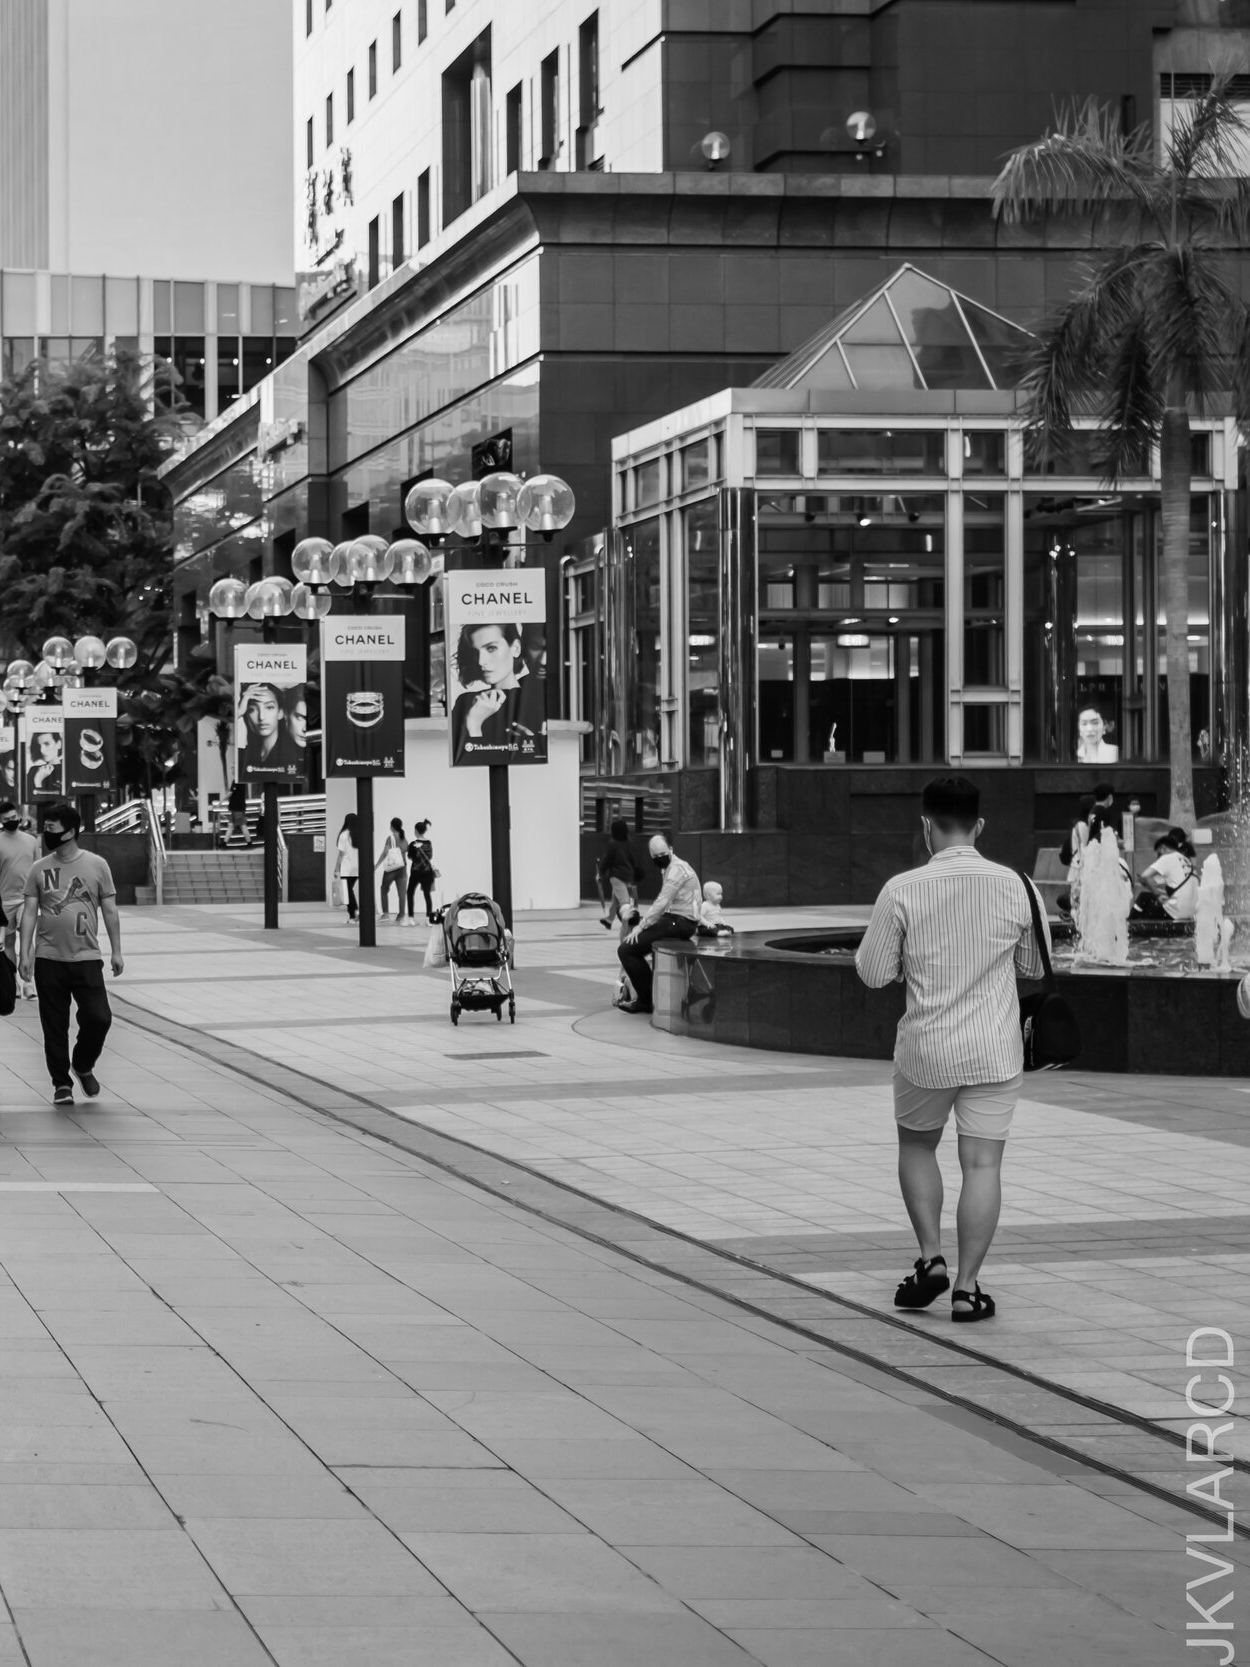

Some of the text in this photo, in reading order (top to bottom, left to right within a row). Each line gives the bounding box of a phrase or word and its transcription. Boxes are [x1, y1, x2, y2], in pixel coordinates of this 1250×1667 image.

[461, 592, 533, 605] CHANEL
[335, 635, 395, 645] CHANEL
[246, 660, 298, 670] CHANEL
[70, 700, 110, 708] CHANEL
